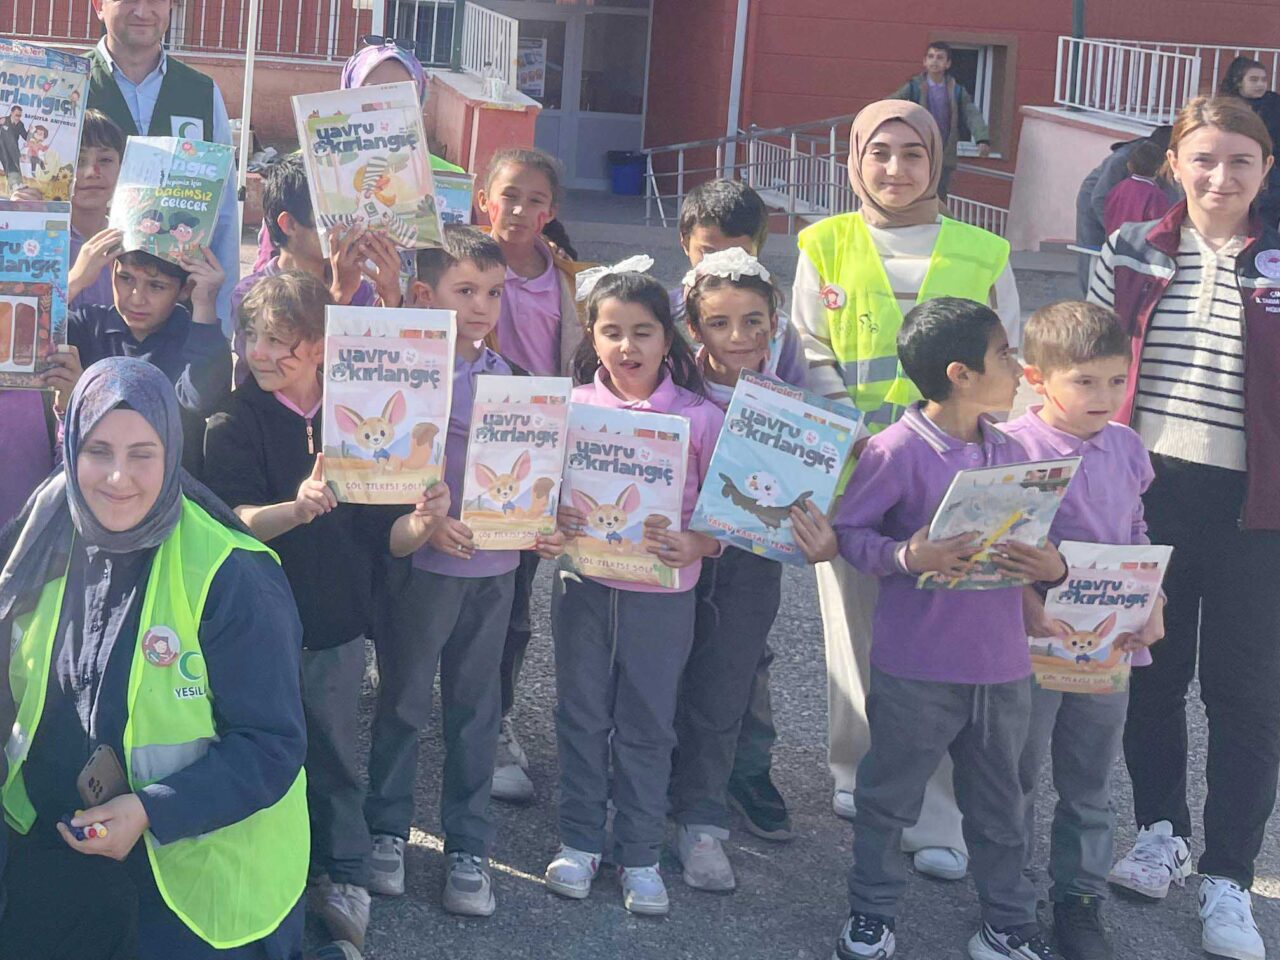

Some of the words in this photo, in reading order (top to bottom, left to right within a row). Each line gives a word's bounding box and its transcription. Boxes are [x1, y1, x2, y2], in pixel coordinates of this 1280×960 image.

[316, 121, 375, 141] yavru
[332, 132, 417, 154] kırlangıç
[338, 348, 401, 365] yavru
[348, 362, 441, 389] kırlangıç
[482, 413, 531, 429] yavru
[740, 406, 802, 439] yavru
[488, 427, 559, 449] kırlangıç
[575, 440, 635, 458] yavru
[745, 427, 837, 474] kırlangıç
[585, 454, 674, 486] kırlangıç
[1068, 578, 1123, 593] yavru
[1073, 591, 1149, 608] kırlangıç
